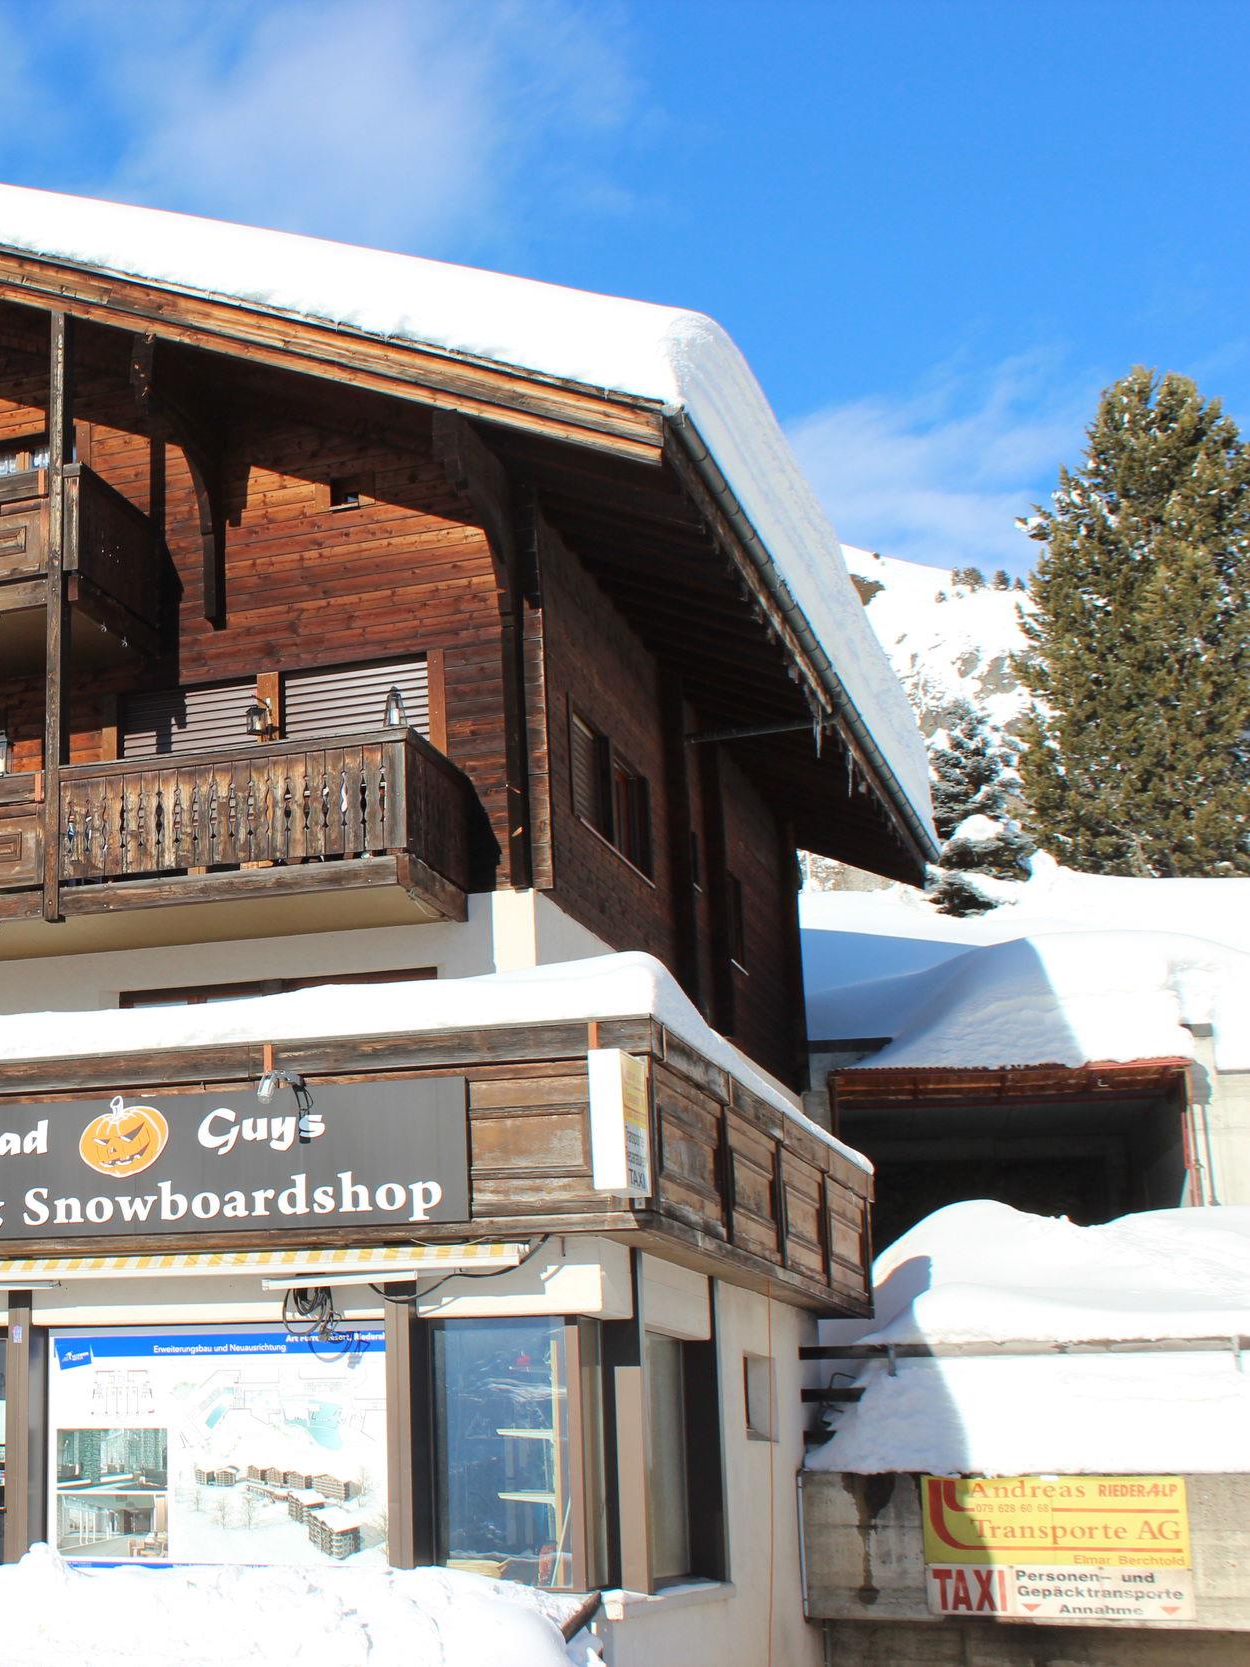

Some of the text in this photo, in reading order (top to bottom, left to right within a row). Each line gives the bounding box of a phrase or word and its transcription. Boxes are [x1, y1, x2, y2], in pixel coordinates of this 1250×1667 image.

[197, 1107, 326, 1155] Guys
[23, 1171, 442, 1226] Snowboardshop
[327, 1332, 352, 1342] esort,
[153, 1342, 286, 1354] Erweiterungsbau und Neuausrichtung
[969, 1480, 1086, 1498] Andreas
[975, 1503, 994, 1513] 079
[970, 1518, 1182, 1545] Transporte AG
[1073, 1555, 1186, 1566] Elmar Berchtold
[1121, 1572, 1155, 1584] und
[932, 1568, 1008, 1612] TAXI
[1059, 1603, 1144, 1615] Annahme
